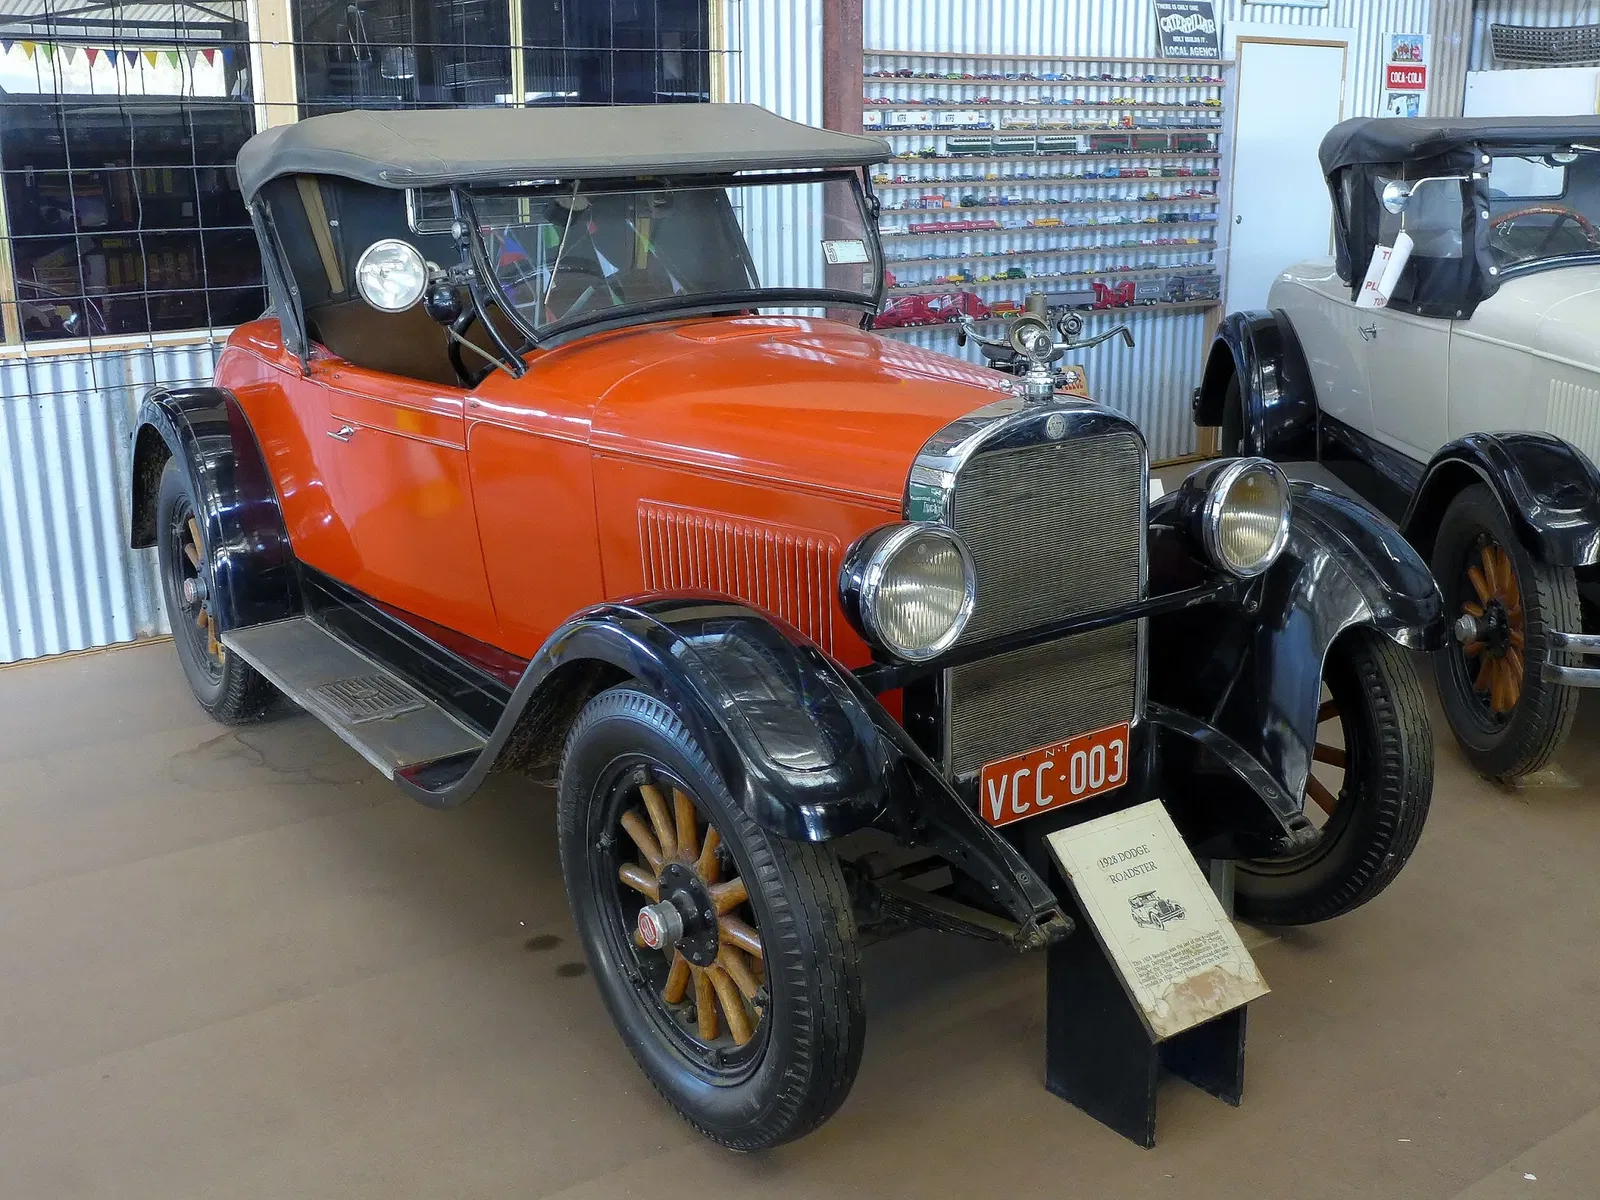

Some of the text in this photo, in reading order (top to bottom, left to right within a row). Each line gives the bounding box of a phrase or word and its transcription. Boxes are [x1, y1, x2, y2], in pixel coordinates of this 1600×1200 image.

[1160, 13, 1216, 34] CATERPILLAR
[1164, 46, 1217, 57] LOCAL AGENCY
[1390, 72, 1422, 84] COCA-COLA
[1100, 844, 1150, 868] 1928 DODGE
[1109, 860, 1158, 884] ROADSTER
